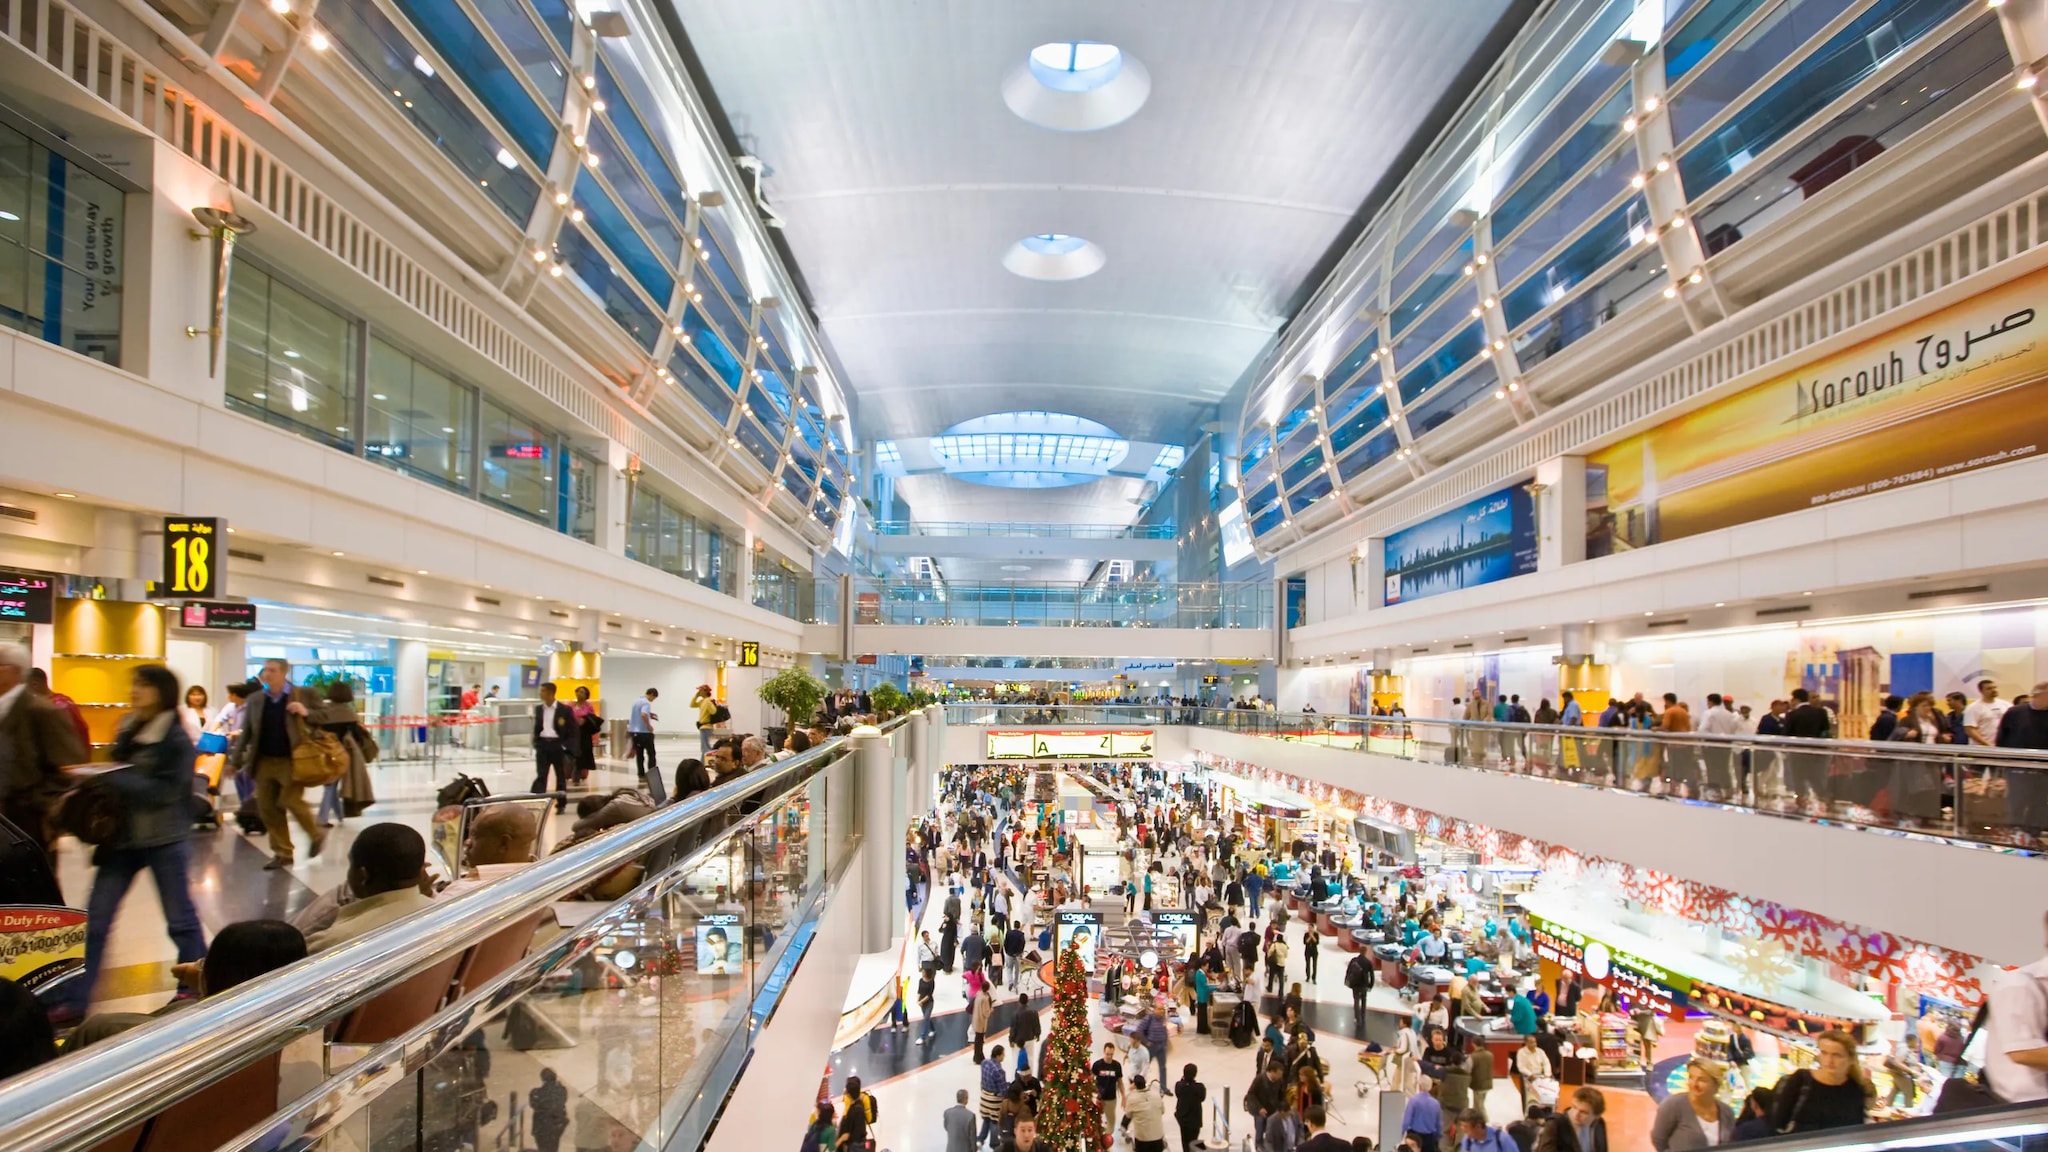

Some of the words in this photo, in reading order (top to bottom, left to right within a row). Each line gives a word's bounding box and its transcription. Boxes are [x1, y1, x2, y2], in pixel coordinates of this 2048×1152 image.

[85, 201, 100, 270] gateway
[100, 217, 116, 275] growth
[82, 277, 96, 312] Your
[1811, 350, 1903, 413] Sorouh
[1936, 444, 2037, 475] www.sorouh.com
[171, 537, 209, 593] 18
[744, 647, 757, 665] 16
[1037, 741, 1049, 754] A
[1100, 736, 1109, 749] Z
[4, 915, 33, 928] Duty
[35, 914, 61, 925] Free
[1541, 920, 1585, 946] FOOD
[1534, 929, 1583, 960] TOBACCO
